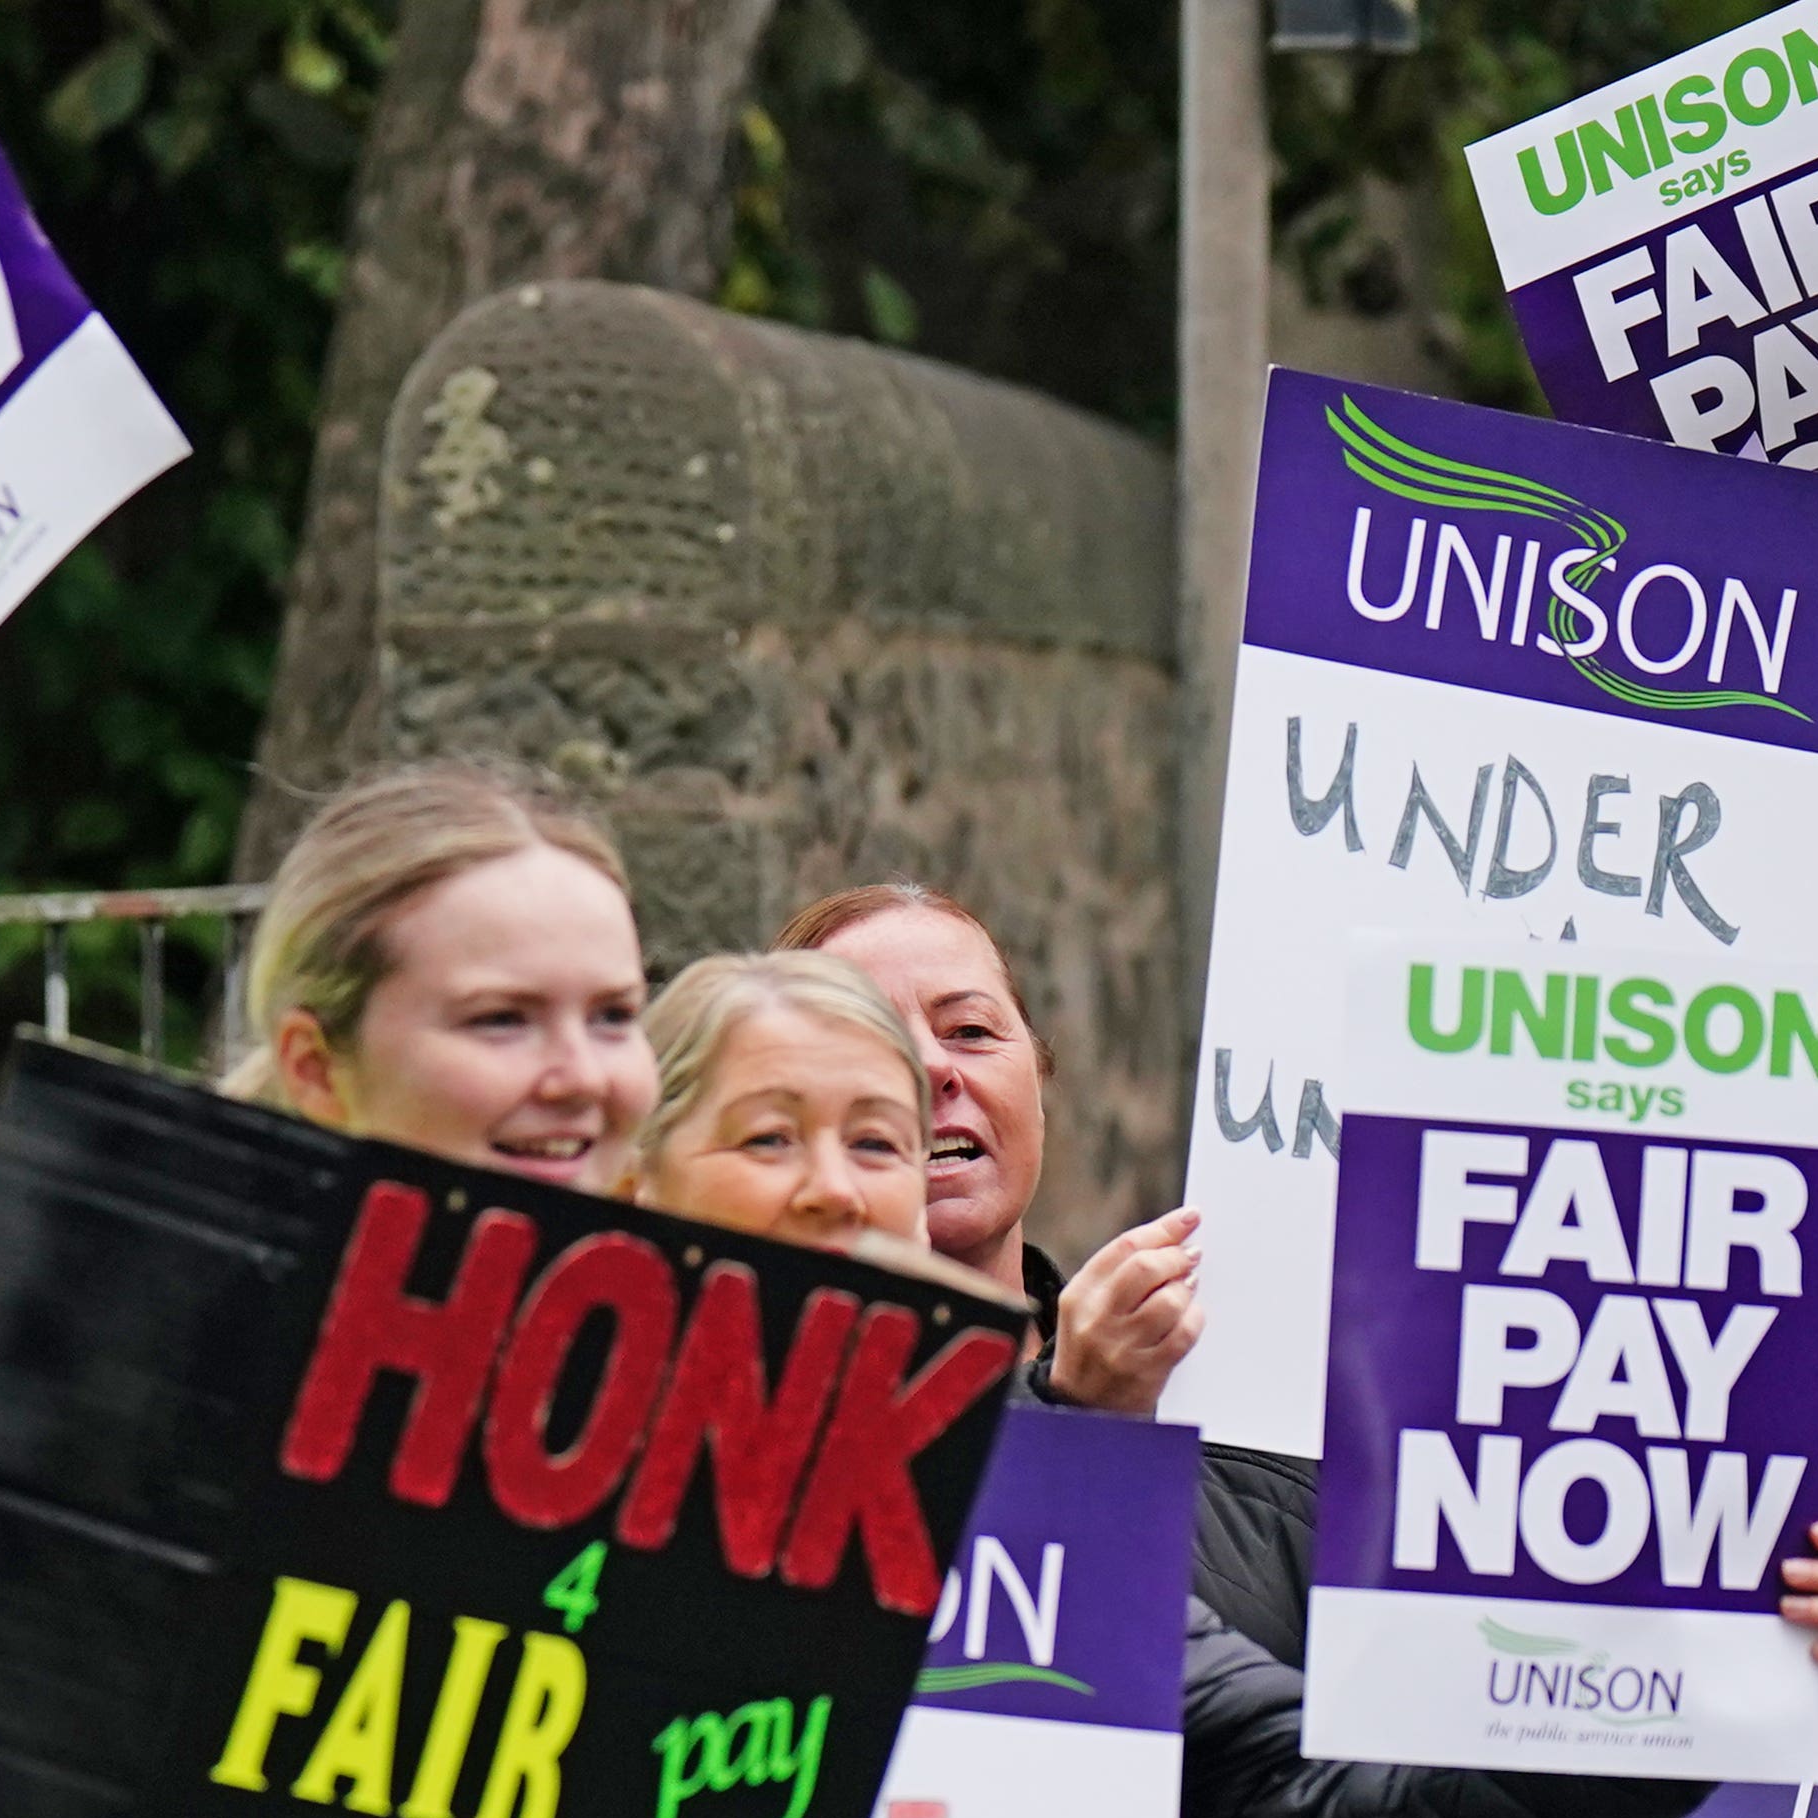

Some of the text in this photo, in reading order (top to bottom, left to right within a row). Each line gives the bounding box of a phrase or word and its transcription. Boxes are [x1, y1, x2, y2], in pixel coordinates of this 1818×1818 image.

[1658, 144, 1752, 209] says
[1345, 506, 1798, 695] UNISON
[1286, 714, 1741, 947] UNDER
[1565, 1075, 1687, 1123] says
[1415, 1128, 1809, 1298] FAIR
[279, 1180, 1019, 1618] HONK
[1456, 1282, 1780, 1441] PAY
[542, 1540, 607, 1632] 4
[1393, 1427, 1808, 1592] NOW
[1486, 1718, 1511, 1738] the
[1517, 1721, 1569, 1746] public
[1488, 1659, 1684, 1714] UNISON
